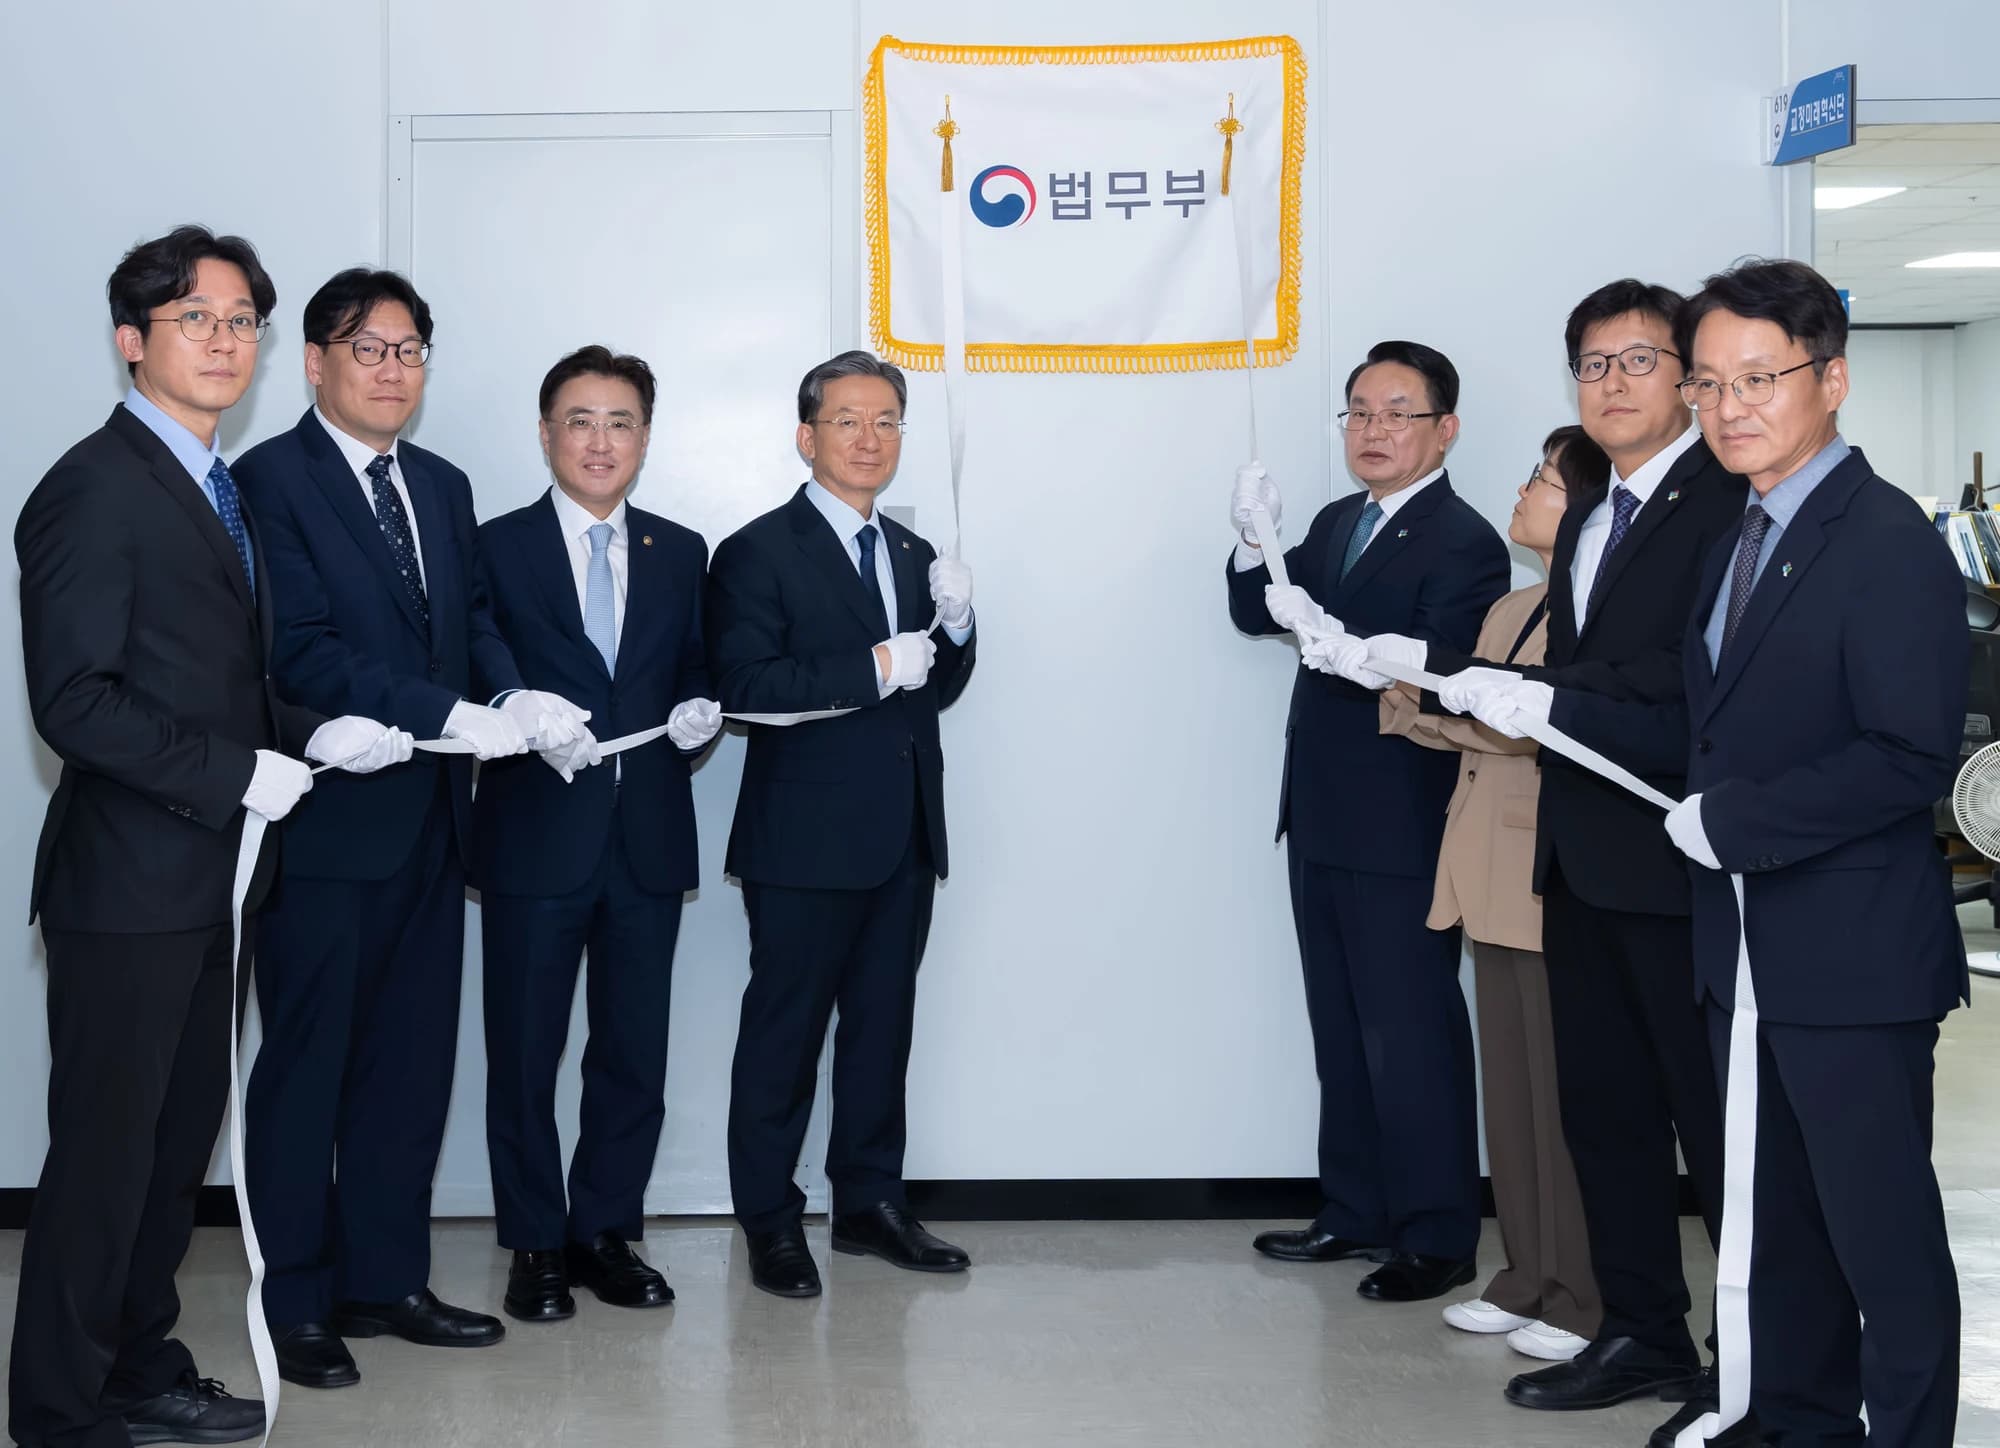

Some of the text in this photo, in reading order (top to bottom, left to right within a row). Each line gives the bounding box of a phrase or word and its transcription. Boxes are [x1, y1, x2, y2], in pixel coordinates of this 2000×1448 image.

[1774, 93, 1789, 115] 619
[1790, 93, 1845, 132] 교정미래혁신단
[1049, 169, 1206, 221] 법무부
